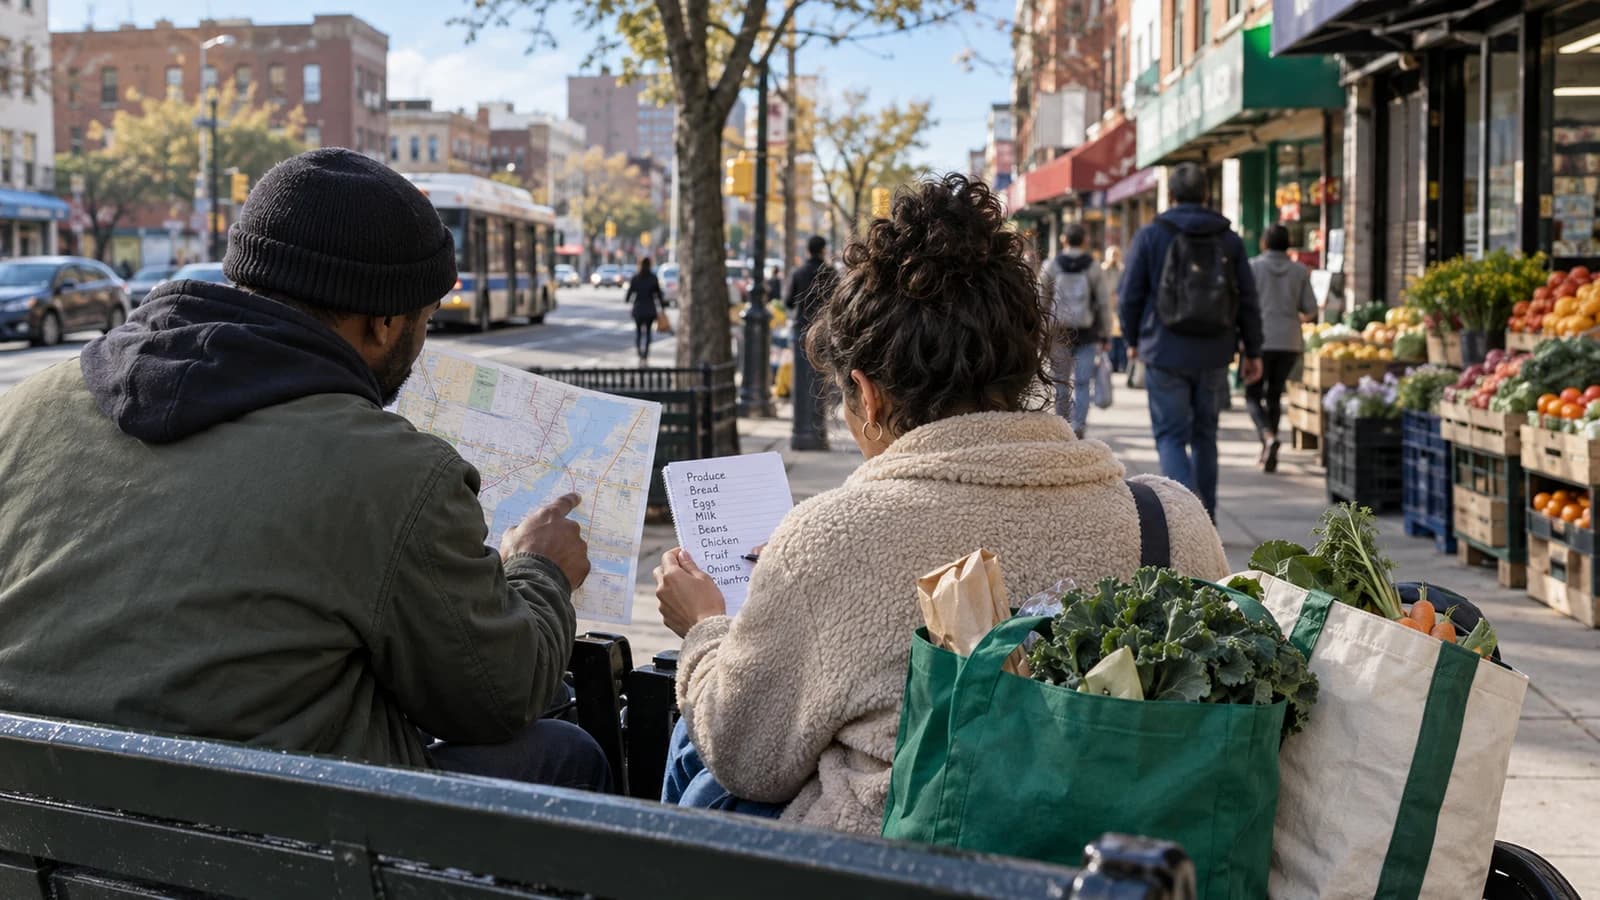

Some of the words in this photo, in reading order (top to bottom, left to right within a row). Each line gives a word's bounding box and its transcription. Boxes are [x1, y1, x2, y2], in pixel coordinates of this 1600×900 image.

[686, 472, 726, 482] Produce
[689, 484, 719, 496] Bread
[692, 499, 716, 511] Eggs
[695, 511, 717, 521] Milk
[698, 525, 728, 535] Beans
[701, 537, 739, 548] Chicken
[704, 550, 729, 561] Fruit
[707, 564, 741, 574] Onions
